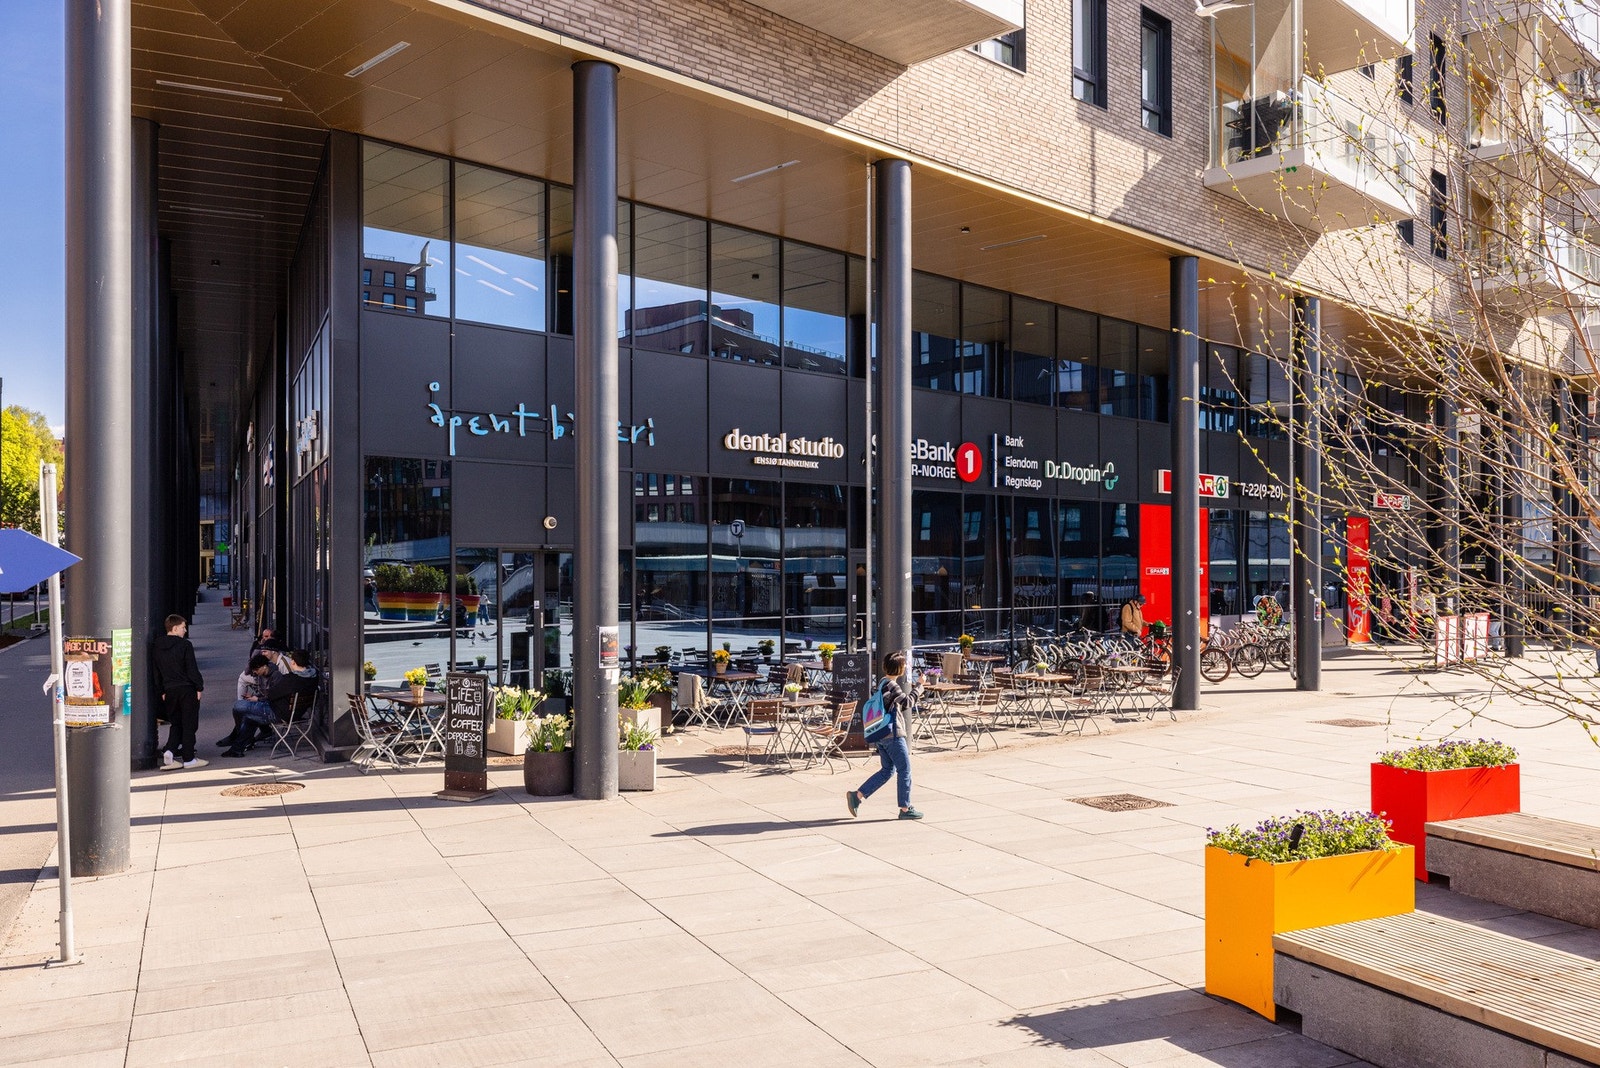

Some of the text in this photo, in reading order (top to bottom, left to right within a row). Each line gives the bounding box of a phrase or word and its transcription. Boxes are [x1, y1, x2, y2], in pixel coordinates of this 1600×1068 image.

[428, 381, 655, 456] åpent beri
[725, 429, 844, 459] dental studio
[1005, 436, 1024, 448] Bank
[777, 459, 819, 469] TANNKLINIKK
[964, 450, 974, 474] 1
[1005, 456, 1038, 470] Eiendom
[1045, 460, 1101, 484] Dr.Dropin
[1005, 475, 1042, 490] Regnskap
[83, 642, 107, 654] CLUB
